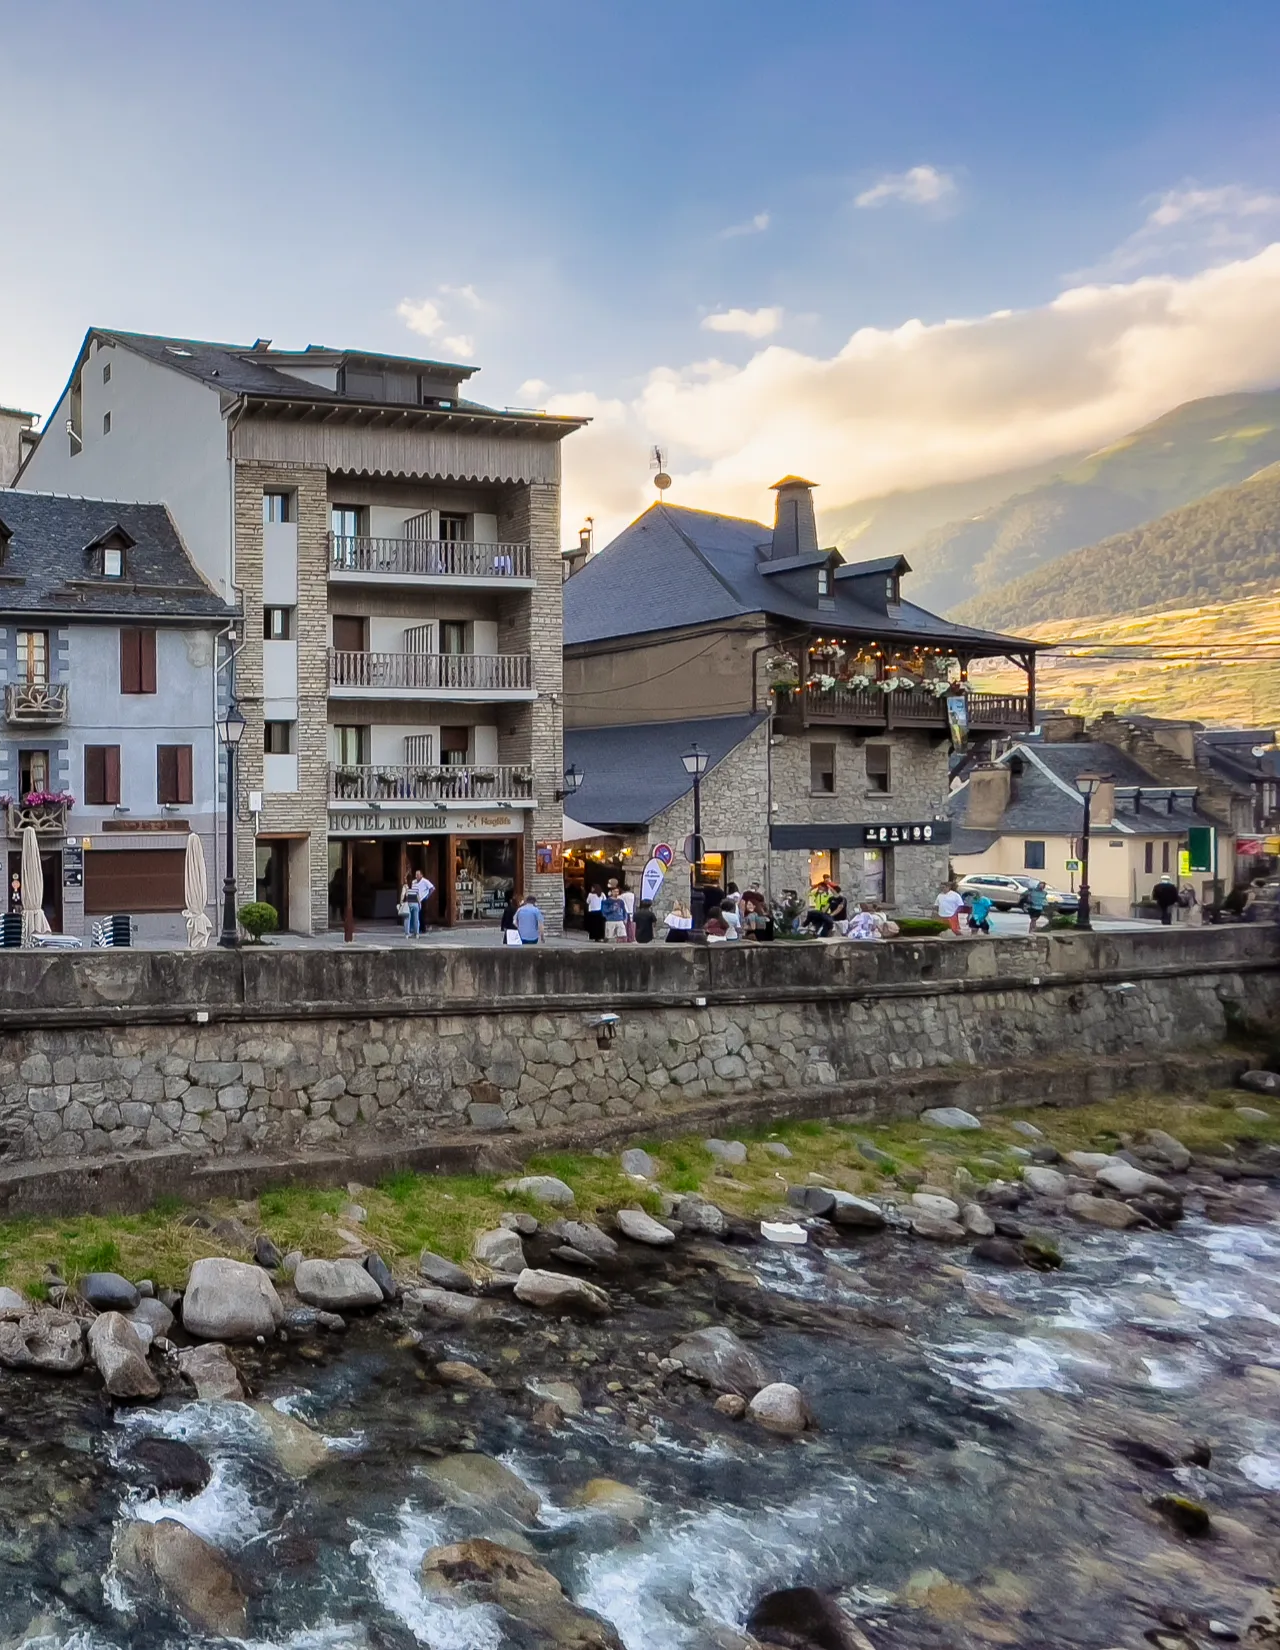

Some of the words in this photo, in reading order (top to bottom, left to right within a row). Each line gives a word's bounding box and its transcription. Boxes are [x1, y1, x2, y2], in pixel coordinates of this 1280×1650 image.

[328, 813, 384, 831] HOTEL
[389, 816, 411, 830] RIU
[415, 815, 447, 830] NERE
